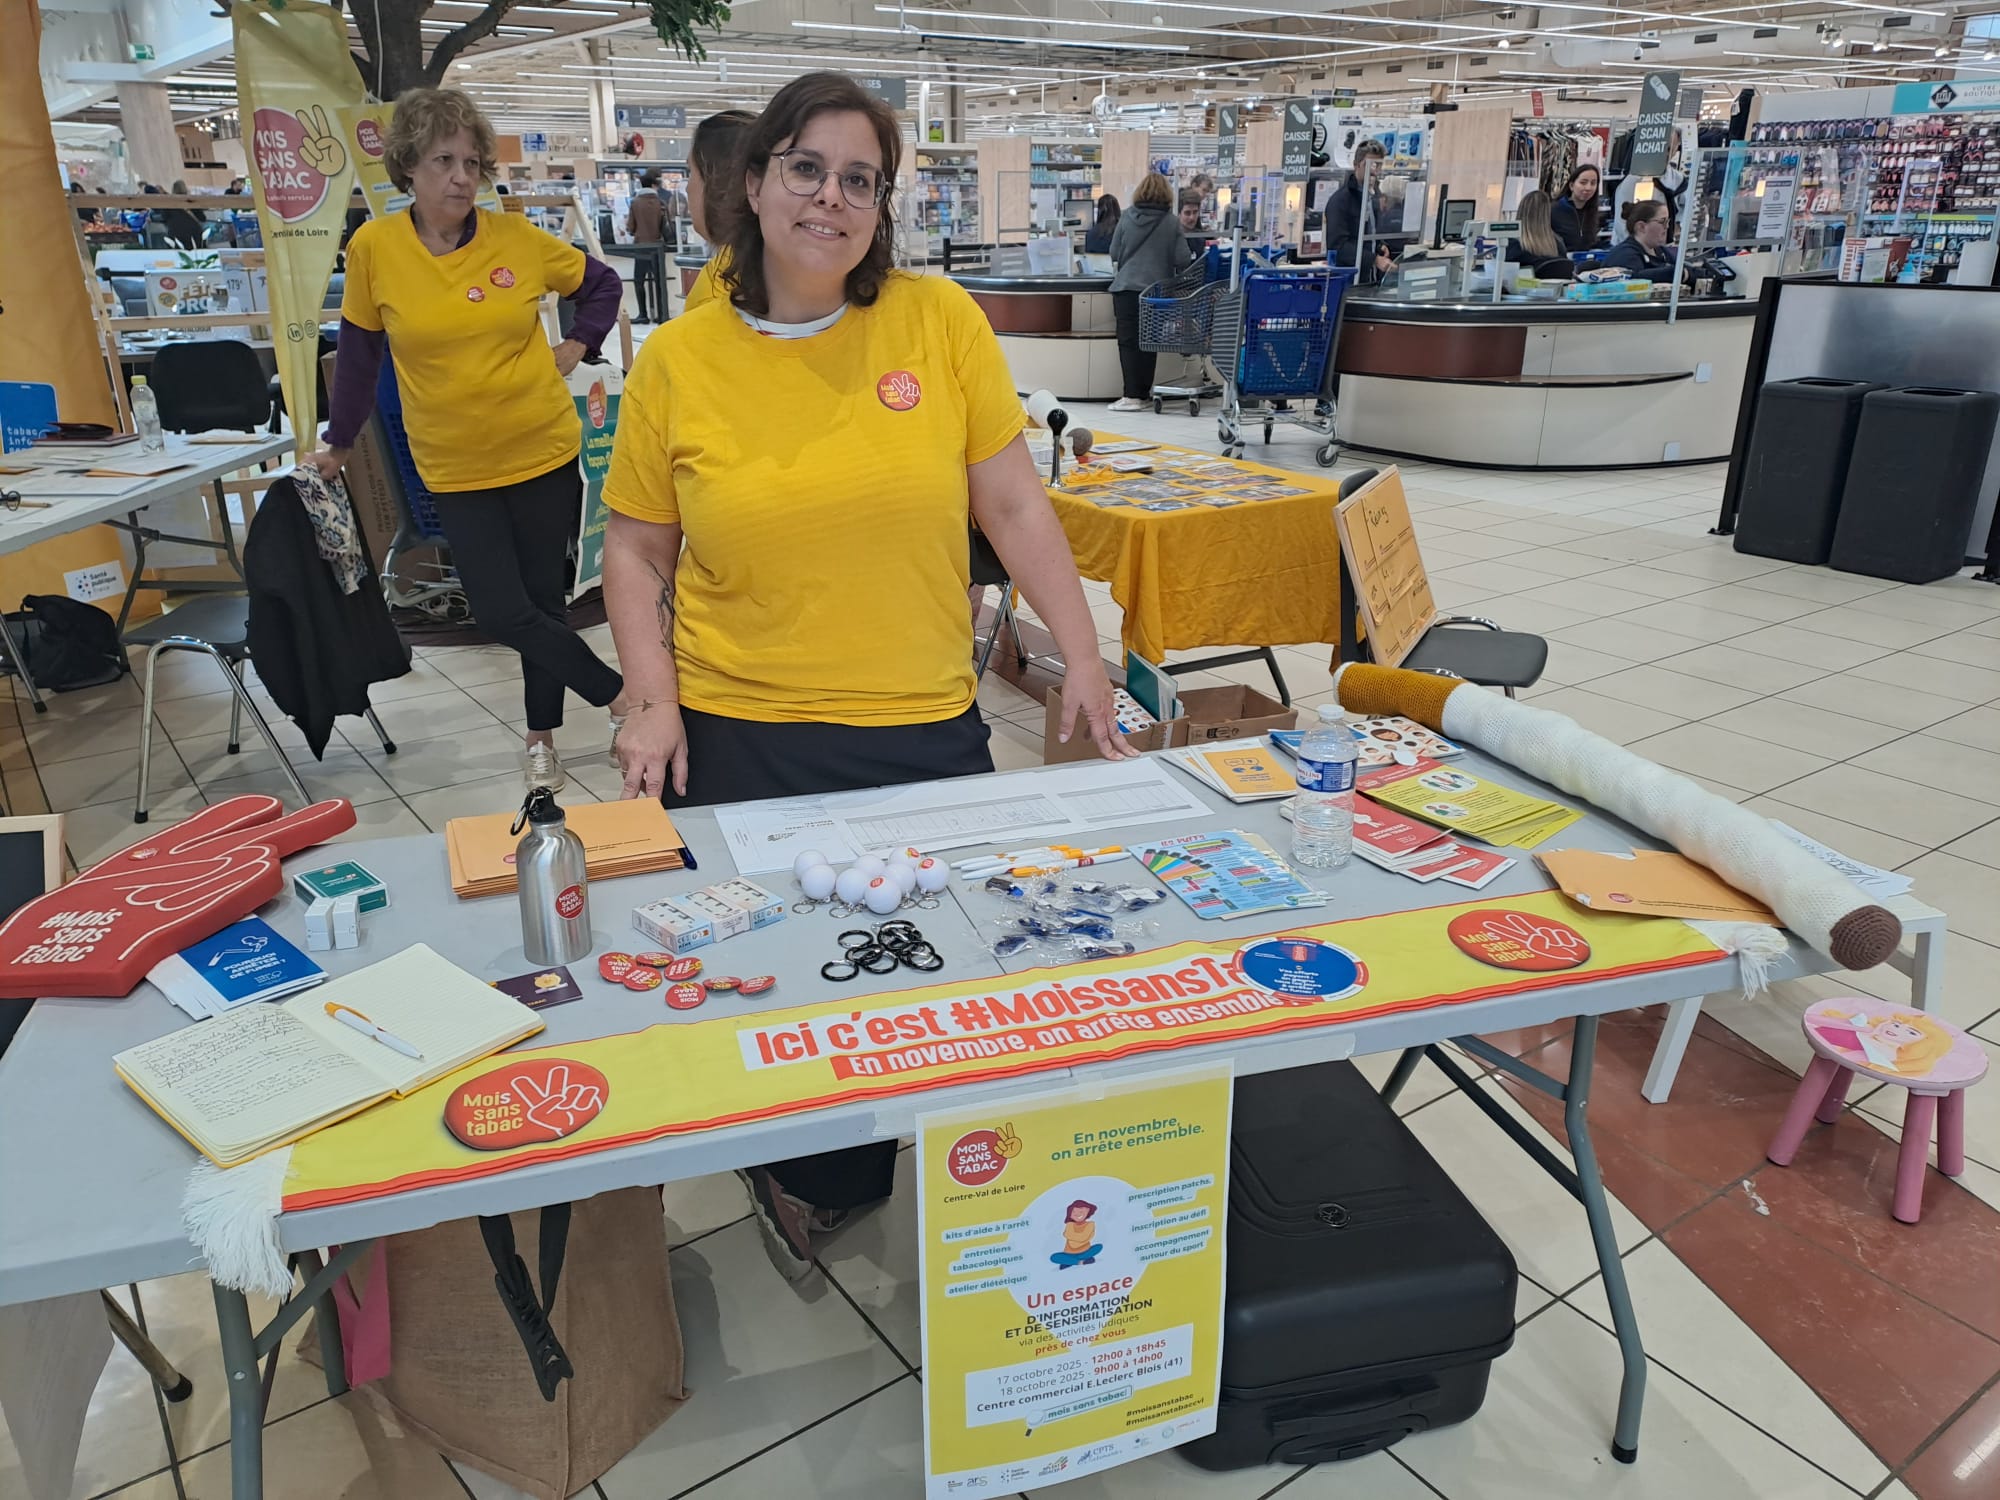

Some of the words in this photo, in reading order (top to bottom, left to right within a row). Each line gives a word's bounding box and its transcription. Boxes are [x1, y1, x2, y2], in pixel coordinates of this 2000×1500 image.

[1639, 112, 1673, 126] CAISSE
[1284, 131, 1311, 142] CAISSE
[1640, 127, 1666, 139] SCAN
[1635, 141, 1667, 154] ACHAT
[1285, 155, 1306, 165] SCAN
[1284, 166, 1308, 176] ACHAT
[307, 228, 329, 237] Loire
[7, 426, 38, 436] tabac
[558, 891, 577, 903] MOIS
[560, 899, 583, 914] TABAC
[561, 896, 579, 909] SANS
[38, 908, 123, 929] #Mois
[1459, 931, 1500, 944] Mois
[1481, 940, 1521, 953] sans
[10, 945, 94, 964] Tabac
[1488, 949, 1536, 963] tabac
[755, 1023, 820, 1065] Ici
[826, 1010, 948, 1050] c'est
[849, 1056, 883, 1075] En
[886, 1033, 1035, 1072] novembre,
[1040, 1027, 1074, 1047] on
[1077, 1011, 1155, 1040] arrête
[1156, 991, 1285, 1026] ensemble
[463, 1091, 512, 1108] Mois
[473, 1102, 521, 1122] sans
[466, 1116, 525, 1137] tabac
[1073, 1132, 1095, 1145] En
[1098, 1118, 1181, 1140] novembre,
[956, 1142, 989, 1156] MOIS
[1051, 1150, 1072, 1161] on
[1074, 1141, 1123, 1157] arrête
[1126, 1124, 1205, 1147] ensemble.
[955, 1160, 998, 1176] TABAC
[959, 1151, 992, 1166] SANS
[943, 1189, 989, 1204] Centre-Val
[991, 1188, 1002, 1196] de
[1003, 1184, 1026, 1194] Loire
[1128, 1185, 1181, 1204] prescription
[945, 1230, 963, 1240] kits
[965, 1225, 993, 1238] d'aide
[995, 1224, 1001, 1232] à
[1003, 1219, 1031, 1231] l'arrêt
[1131, 1217, 1178, 1233] inscription
[1178, 1214, 1190, 1222] au
[1190, 1208, 1206, 1220] défi
[1134, 1229, 1209, 1252] accompagnement
[964, 1244, 1013, 1259] entretiens
[1139, 1249, 1168, 1262] autour
[1169, 1246, 1182, 1256] du
[1182, 1240, 1205, 1253] sport
[952, 1254, 1025, 1272] tabacologiques
[948, 1283, 979, 1295] atelier
[980, 1275, 1029, 1290] diététique
[1026, 1293, 1056, 1310] Un
[1062, 1276, 1133, 1302] espace
[1005, 1328, 1021, 1339] ET
[1024, 1322, 1043, 1336] DE
[1045, 1298, 1154, 1331] SENSIBILISATION
[1026, 1294, 1131, 1325] D'INFORMATION
[1018, 1337, 1034, 1347] via
[1036, 1332, 1054, 1344] des
[1056, 1323, 1096, 1340] activités
[1098, 1313, 1140, 1330] ludiques
[1035, 1344, 1058, 1357] près
[1060, 1338, 1073, 1349] de
[1076, 1332, 1100, 1345] chez
[1102, 1326, 1127, 1339] vous
[996, 1375, 1010, 1386] 17
[1012, 1366, 1054, 1384] octobre
[1056, 1359, 1082, 1373] 2025
[1091, 1349, 1123, 1366] 12h00
[1125, 1347, 1133, 1357] à
[1135, 1338, 1167, 1354] 18h45
[1000, 1386, 1013, 1398] 18
[1015, 1377, 1057, 1395] octobre
[1059, 1369, 1085, 1384] 2025
[1093, 1362, 1120, 1377] 9h00
[1122, 1359, 1130, 1369] à
[1132, 1350, 1163, 1366] 14h00
[976, 1399, 1016, 1413] Centre
[1018, 1382, 1085, 1406] commercial
[1086, 1371, 1135, 1390] E.Leclerc
[1136, 1362, 1162, 1377] Blois
[1164, 1356, 1184, 1370] (41)
[1048, 1407, 1071, 1420] mois
[1073, 1399, 1096, 1412] sans
[1098, 1390, 1126, 1402] tabac
[1126, 1393, 1194, 1418] #moissanstabac
